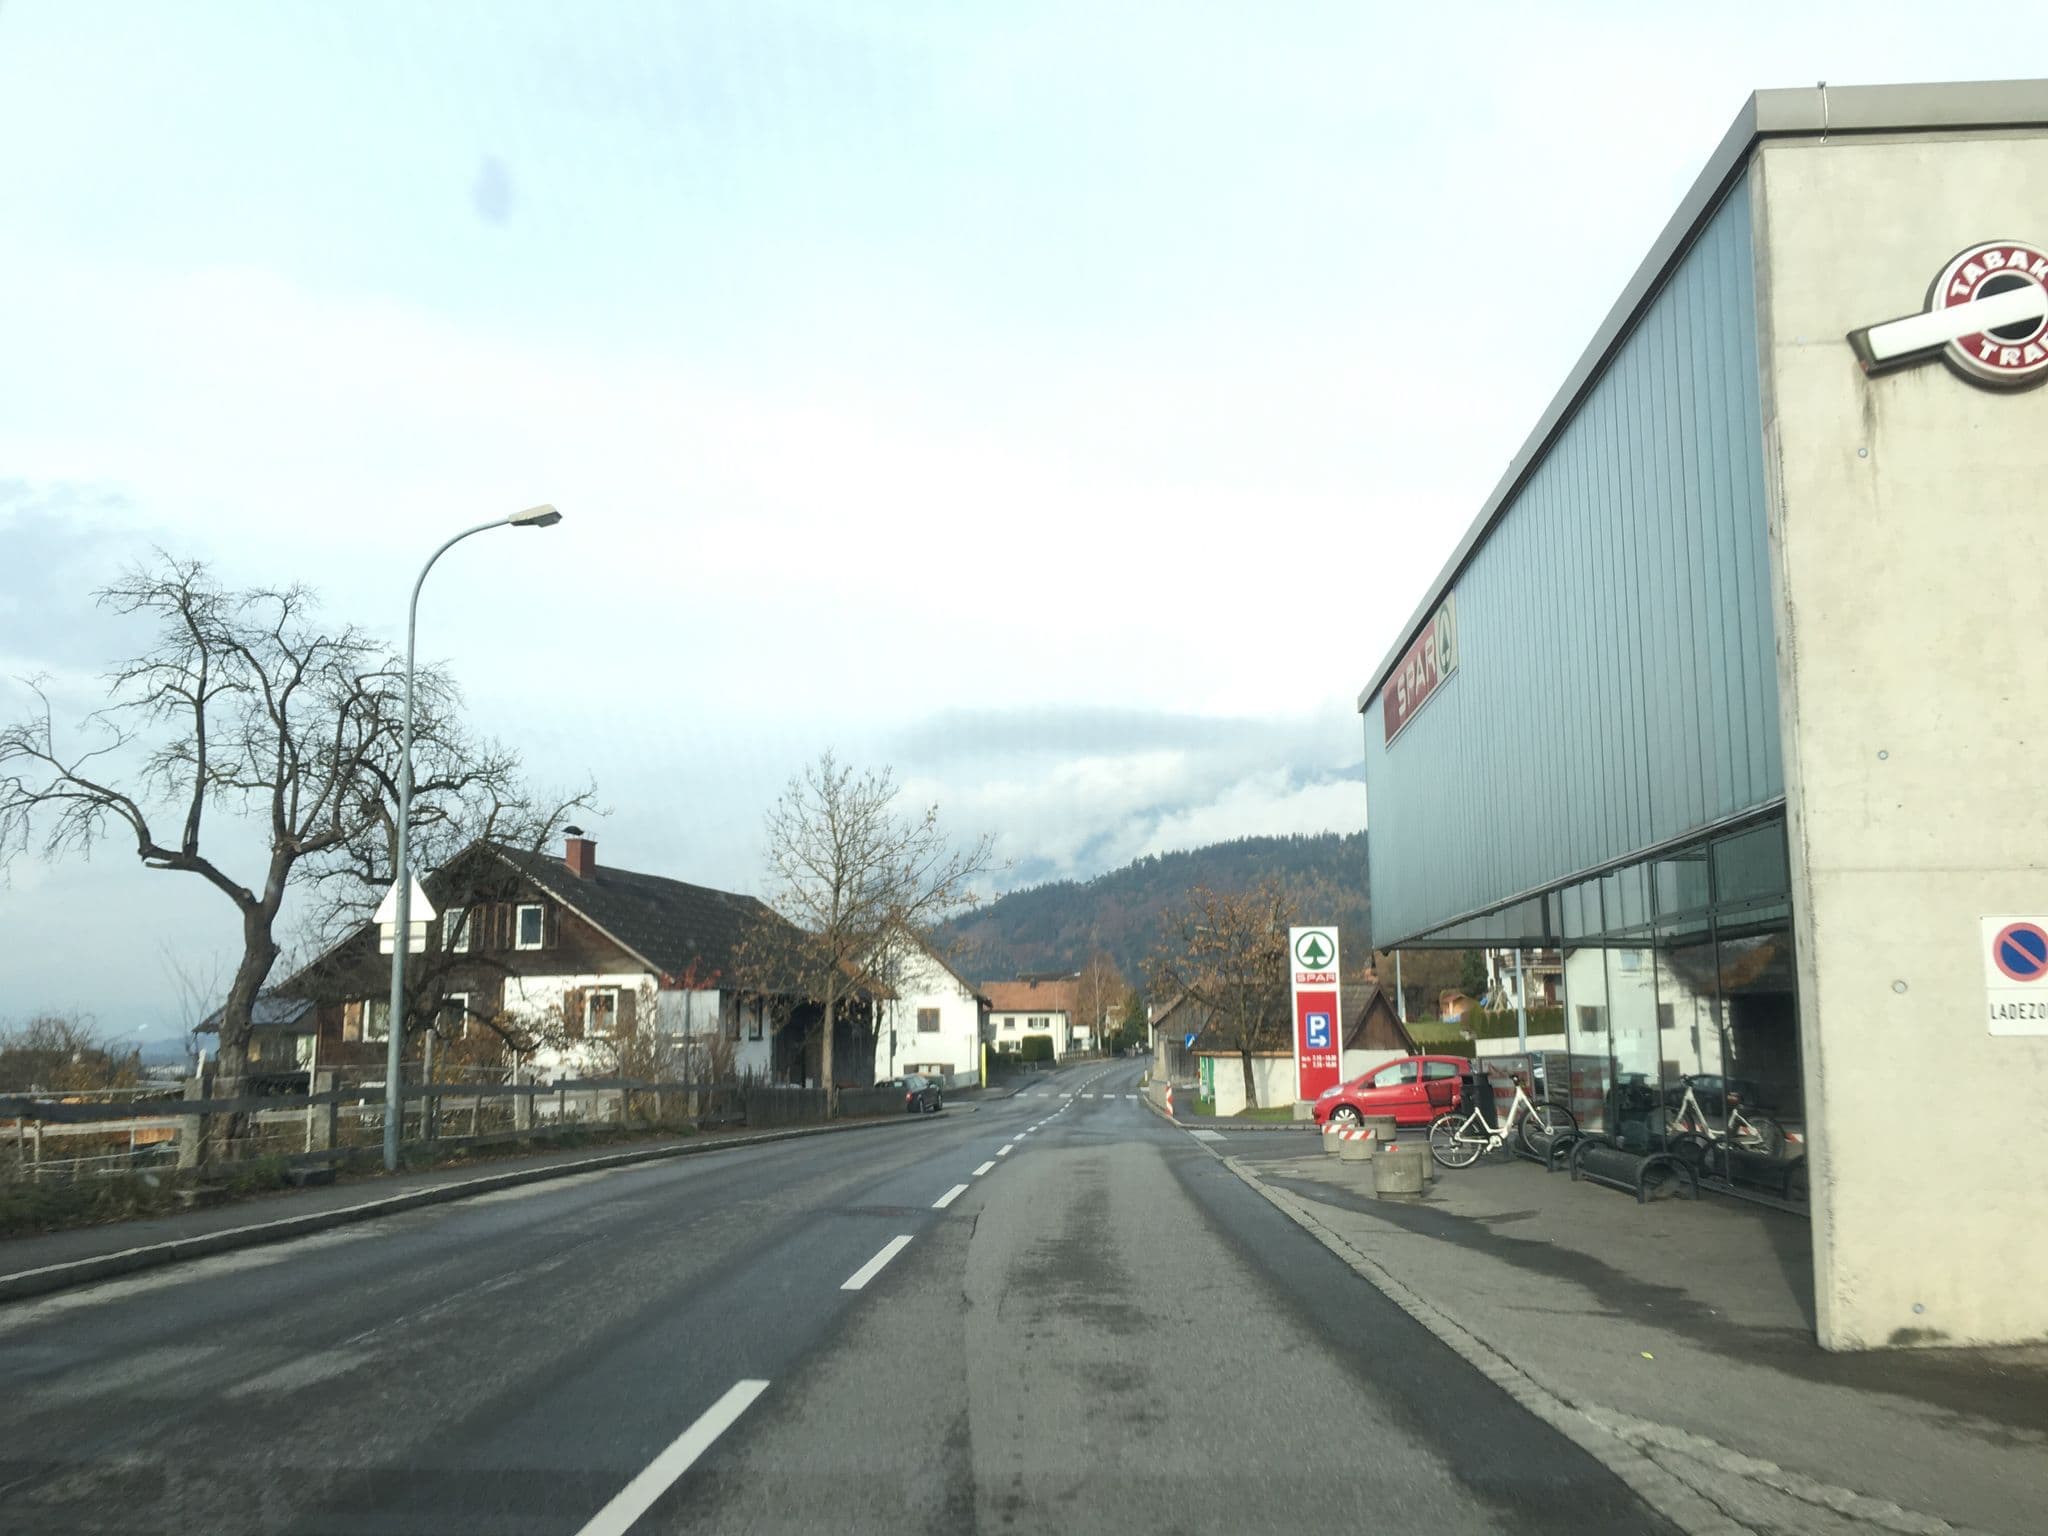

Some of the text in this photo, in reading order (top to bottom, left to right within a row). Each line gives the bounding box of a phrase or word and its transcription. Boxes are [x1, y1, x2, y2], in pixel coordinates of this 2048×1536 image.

[1950, 250, 2048, 297] TABAK
[1397, 633, 1436, 717] SPAR
[1296, 973, 1336, 983] SPAR
[1990, 1002, 2048, 1020] LADEZO
[1310, 1015, 1326, 1037] P
